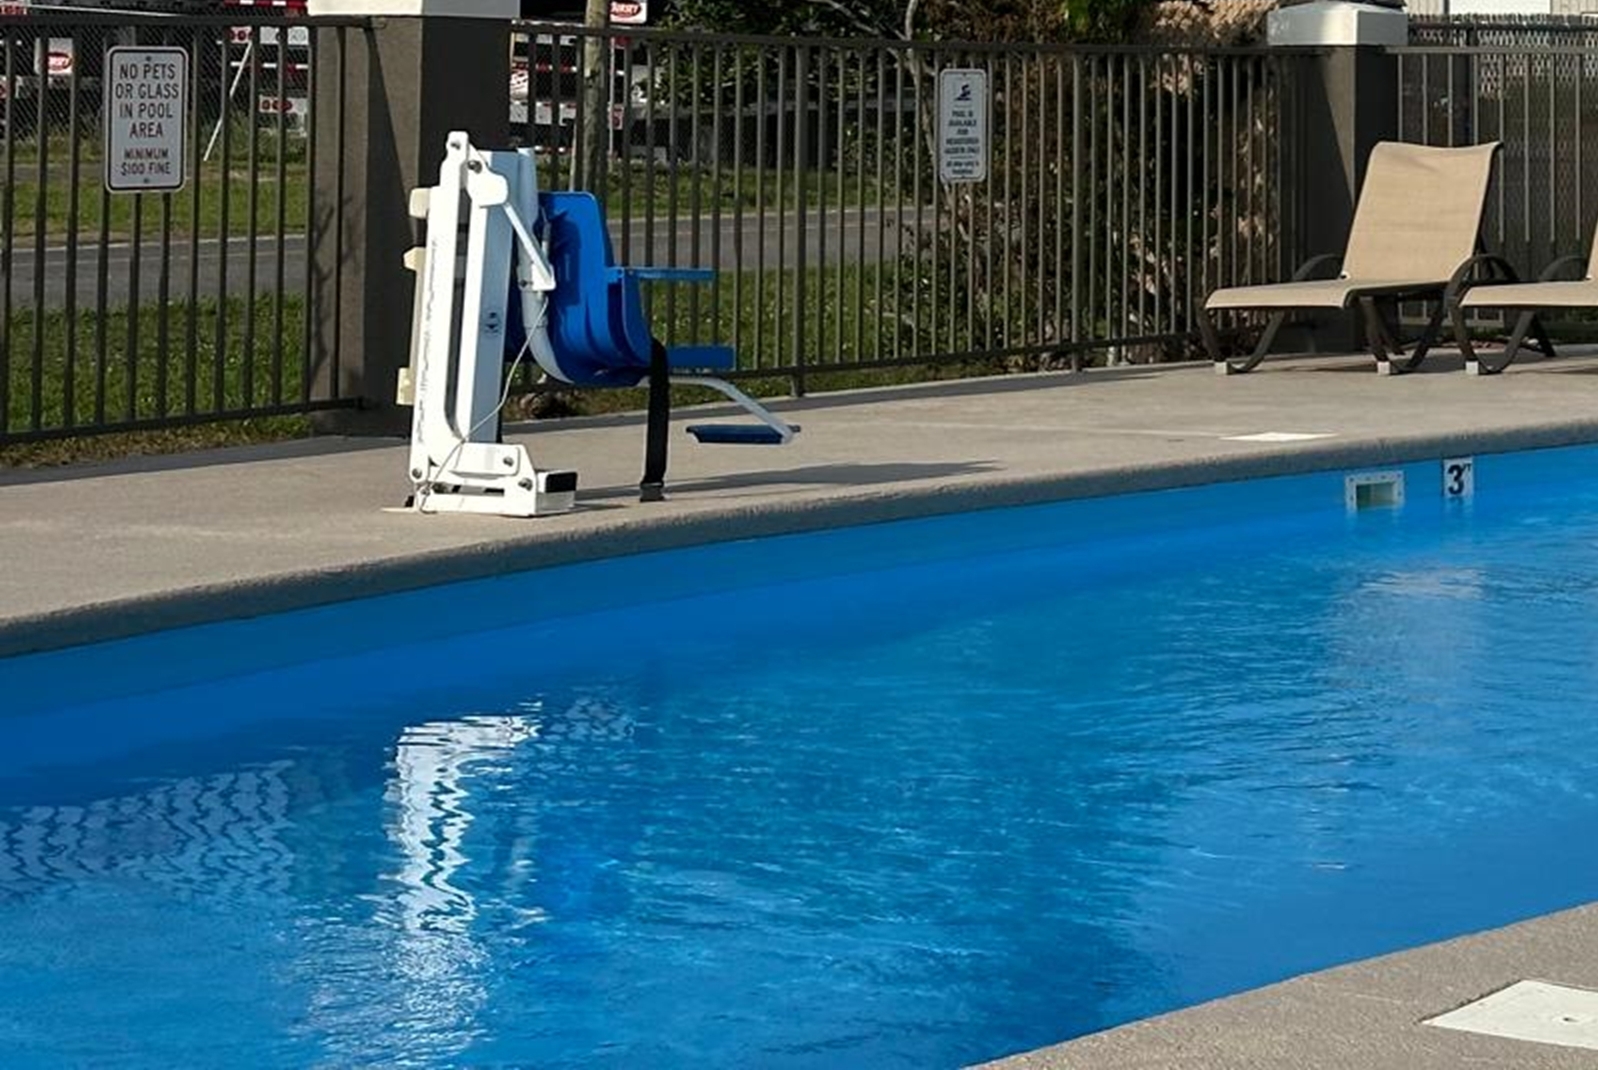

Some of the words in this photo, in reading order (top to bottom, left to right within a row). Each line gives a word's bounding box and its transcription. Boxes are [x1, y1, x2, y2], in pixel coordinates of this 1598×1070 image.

[120, 63, 138, 79] NO
[143, 63, 176, 79] PETS
[115, 83, 133, 99] OR
[138, 82, 179, 99] GLASS
[120, 103, 133, 119] IN
[138, 102, 173, 119] POOL
[129, 122, 164, 138] AREA
[124, 148, 169, 160] MINIMUM
[121, 162, 146, 177] $100
[149, 161, 172, 176] FINE
